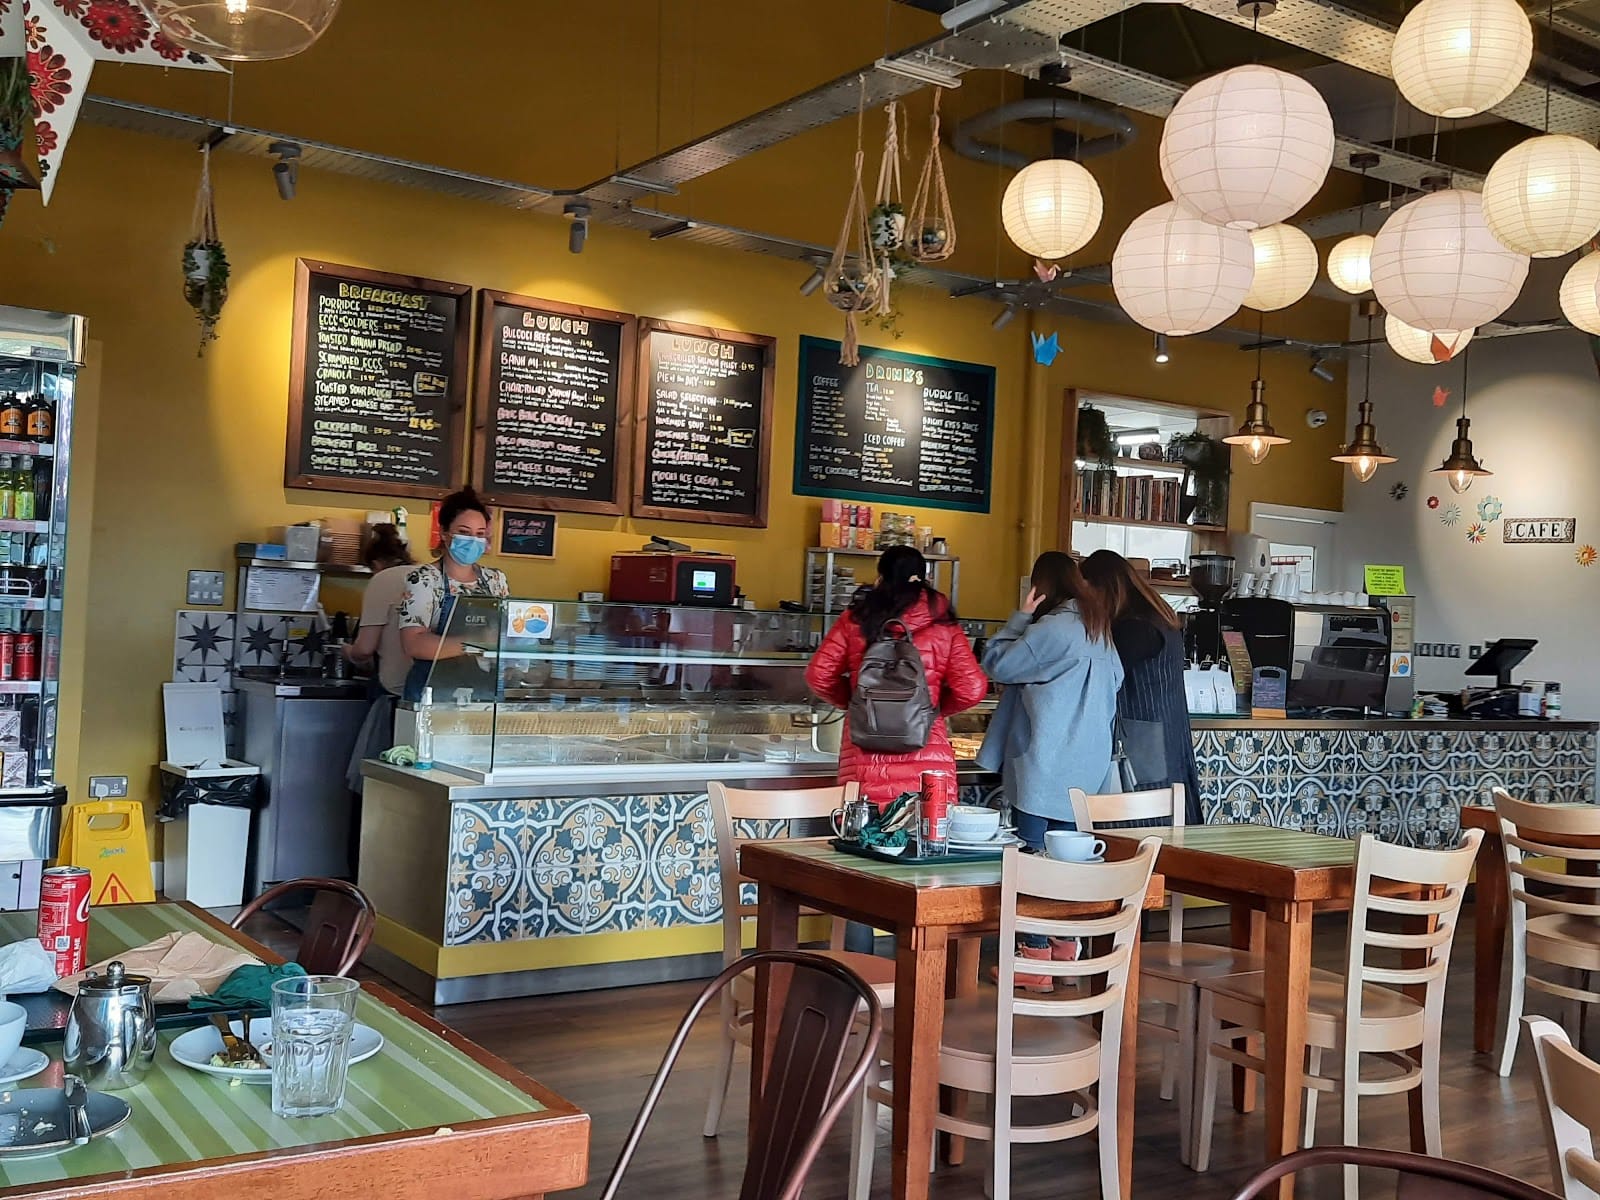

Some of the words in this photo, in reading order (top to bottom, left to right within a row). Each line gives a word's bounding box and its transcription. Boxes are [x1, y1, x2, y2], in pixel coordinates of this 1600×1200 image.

[339, 283, 431, 310] BREAKFAST
[342, 315, 379, 331] SOLDIERS
[522, 312, 589, 336] LUNCH
[318, 332, 348, 346] TOASTED
[350, 335, 377, 350] BANANA
[378, 338, 402, 353] BREAD
[533, 330, 551, 344] BEEF
[672, 339, 735, 360] LUNCH
[316, 368, 352, 380] GRANOLA
[656, 371, 669, 383] PIE
[866, 362, 924, 385] DRINKS
[315, 380, 347, 395] TOASTED
[812, 375, 839, 388] COFFEE
[865, 382, 879, 393] TEA
[314, 395, 350, 407] STEAMED
[655, 388, 678, 401] SALAD
[680, 392, 717, 406] SELECTION
[923, 387, 953, 401] BUBBLE
[863, 433, 881, 445] ICED
[882, 433, 905, 447] COFFEE
[1514, 521, 1561, 538] CAFE
[465, 615, 487, 623] CAFE
